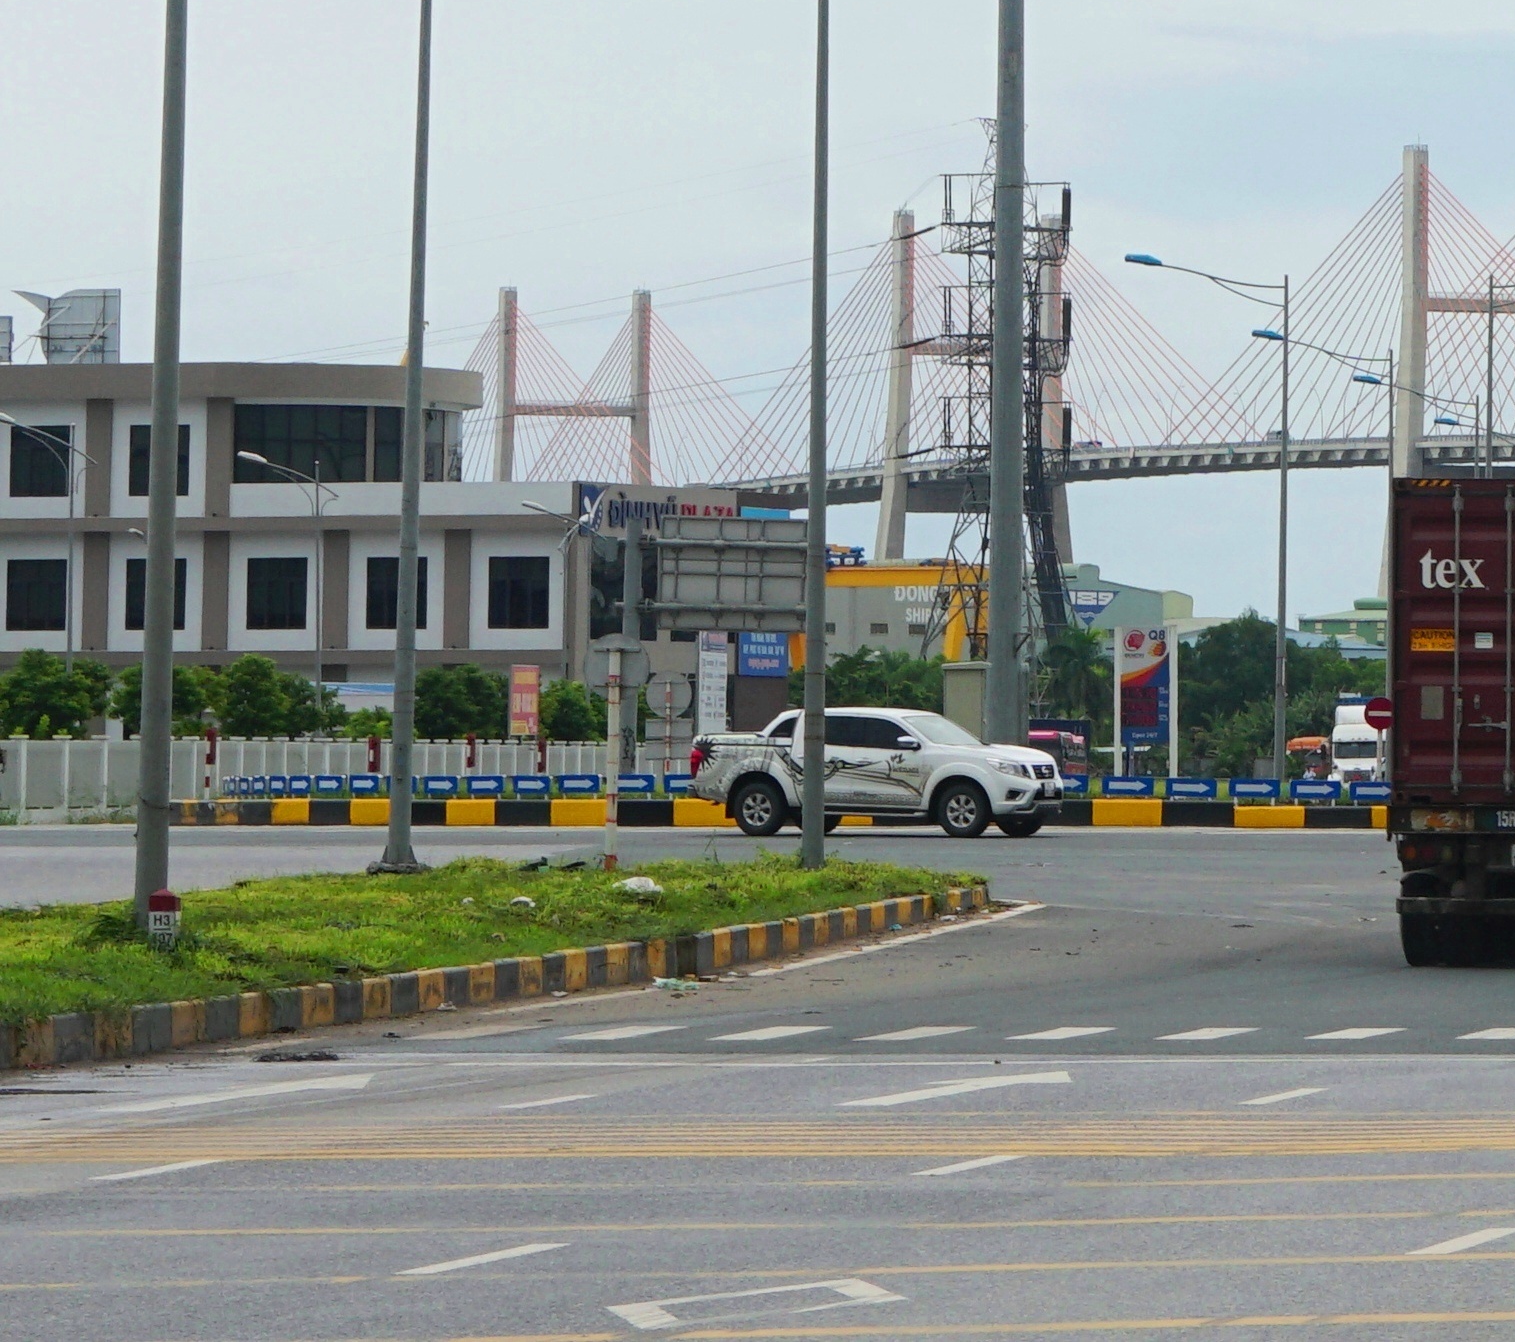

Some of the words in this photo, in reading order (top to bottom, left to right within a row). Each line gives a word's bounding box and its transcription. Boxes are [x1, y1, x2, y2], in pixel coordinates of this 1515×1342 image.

[1419, 548, 1485, 589] tex
[1148, 629, 1166, 640] Q8
[153, 914, 171, 927] H3
